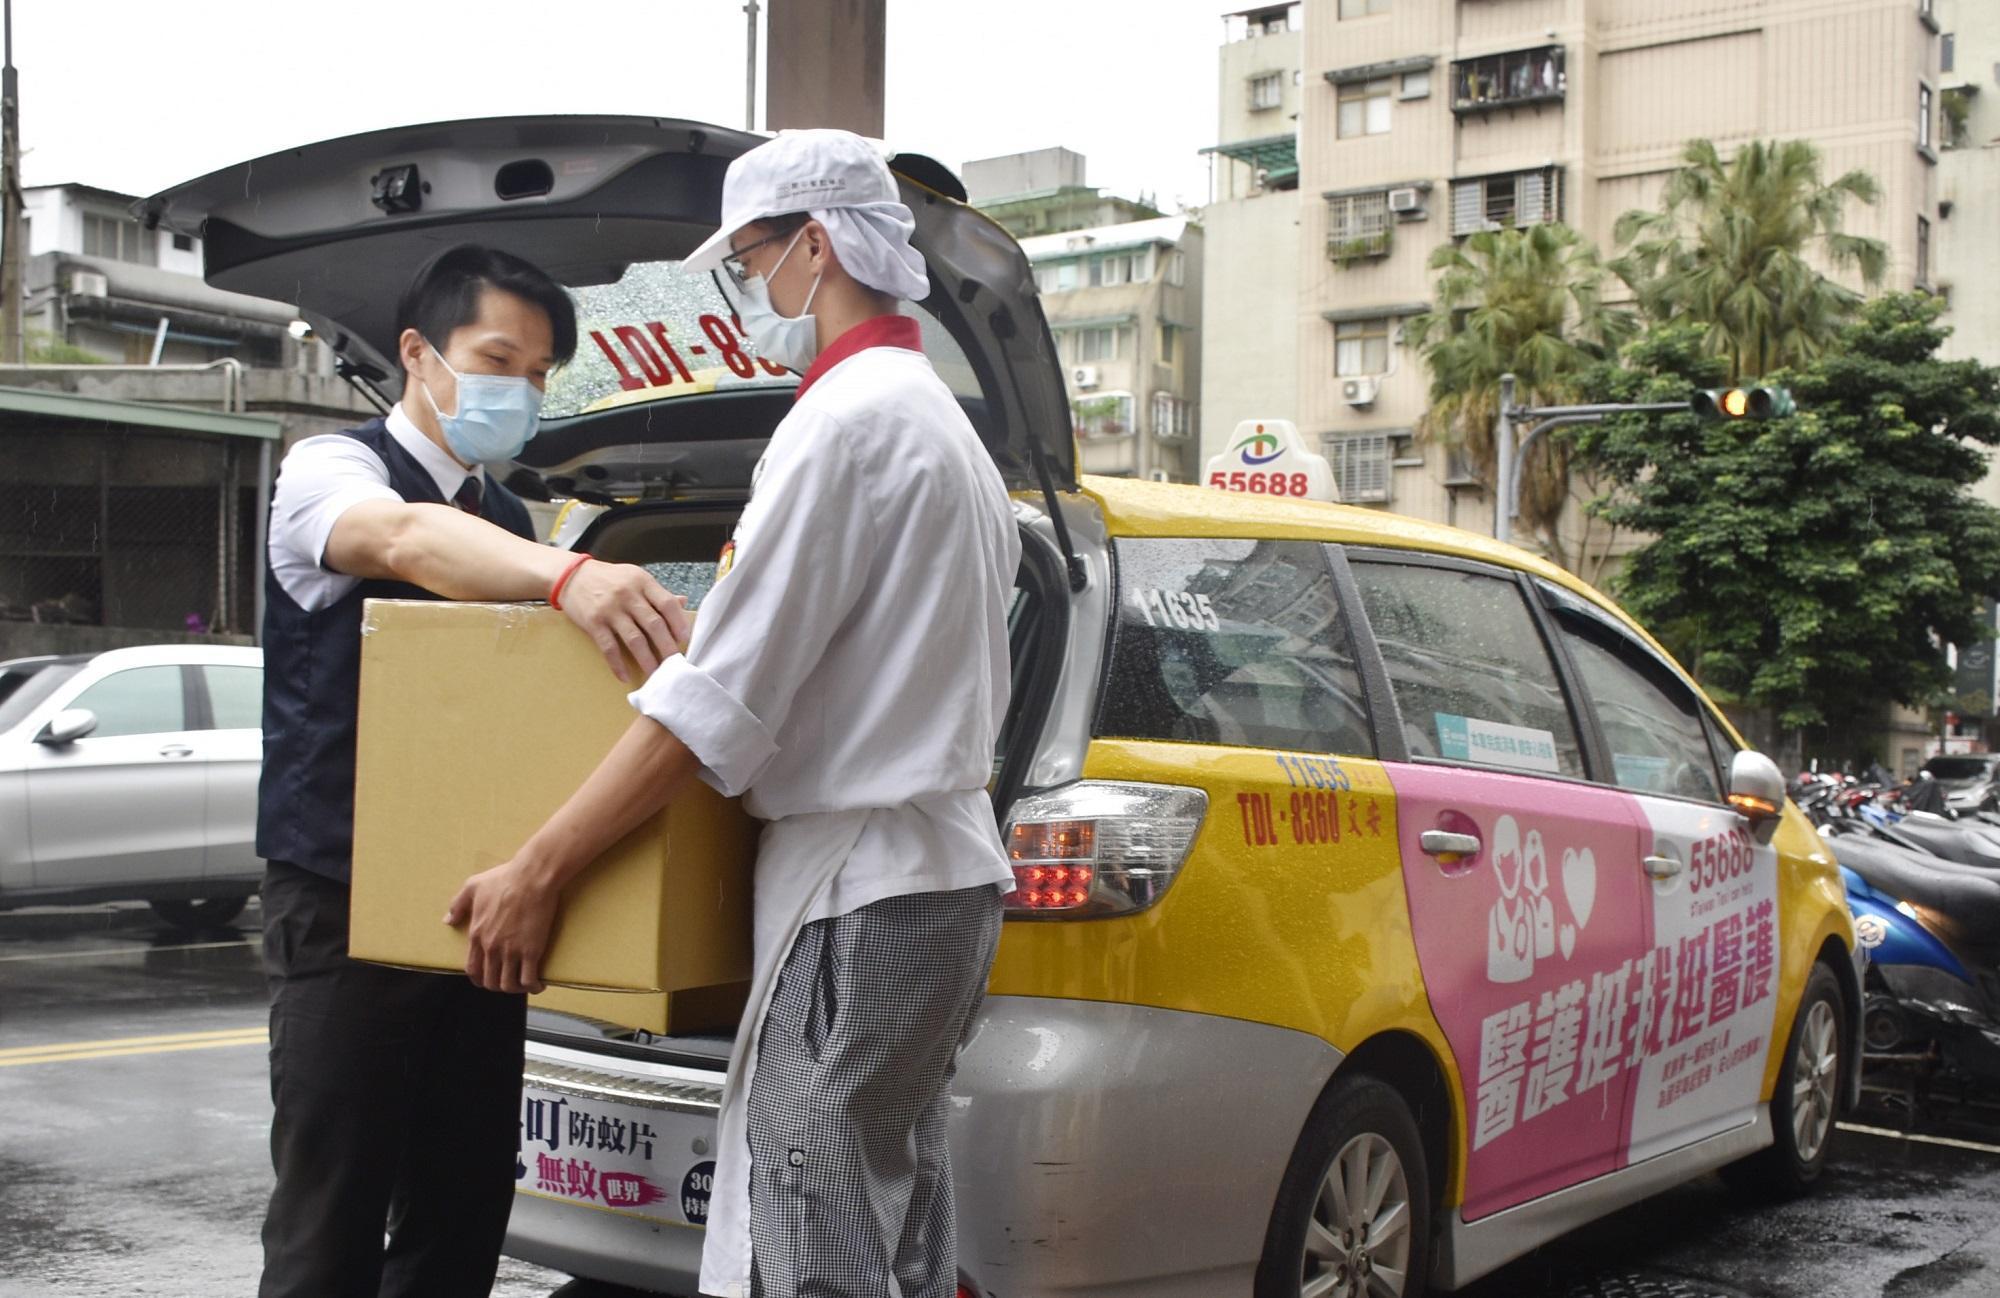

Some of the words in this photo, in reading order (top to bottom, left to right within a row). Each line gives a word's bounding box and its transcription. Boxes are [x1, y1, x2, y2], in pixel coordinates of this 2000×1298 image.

[1209, 472, 1308, 497] 55688
[1131, 587, 1220, 632] 11635
[1276, 752, 1350, 791] 11635
[1689, 826, 1754, 894] 55688
[1473, 898, 1775, 1152] 醫護挺我挺醫護
